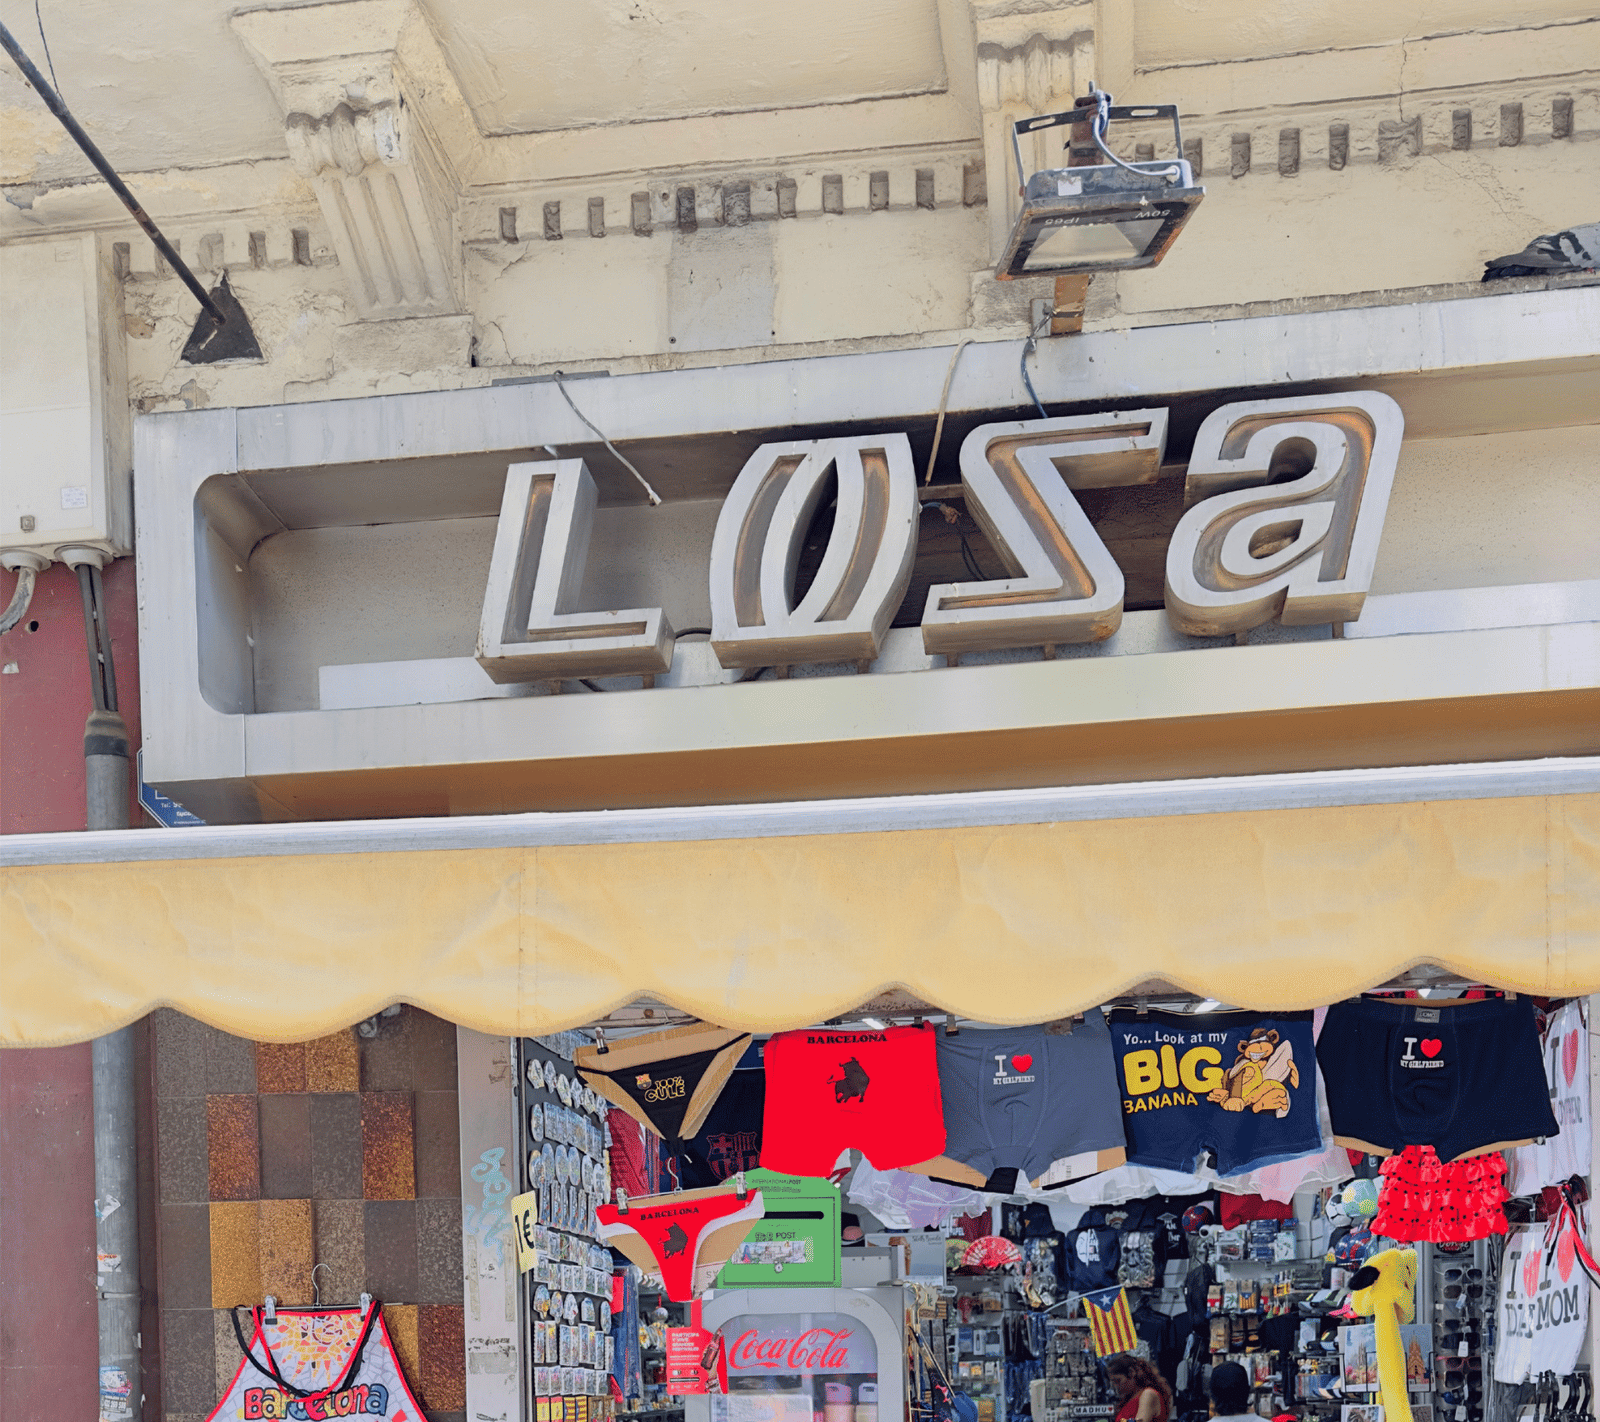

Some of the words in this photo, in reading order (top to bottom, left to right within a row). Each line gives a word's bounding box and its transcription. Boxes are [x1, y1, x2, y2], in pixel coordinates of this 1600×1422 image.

[806, 1033, 888, 1045] BARCELONA
[1123, 1033, 1152, 1046] Yo...
[1155, 1030, 1185, 1045] Look
[1190, 1033, 1203, 1044] at
[1208, 1033, 1228, 1045] my
[1401, 1037, 1418, 1061] I
[994, 1054, 1008, 1077] I
[1123, 1044, 1226, 1096] BIG
[1400, 1060, 1408, 1068] MY
[1408, 1060, 1445, 1069] GIRLFRIEND
[655, 1076, 685, 1090] 100%
[993, 1077, 1002, 1085] MY
[1002, 1075, 1036, 1085] GIRLFRIEND
[1123, 1092, 1199, 1114] BANANA
[639, 1206, 700, 1221] BARCELONA
[514, 1209, 535, 1254] 1€
[776, 1231, 797, 1240] POST
[1536, 1284, 1580, 1332] MOM
[728, 1327, 856, 1370] Coca-Cola
[243, 1383, 389, 1422] Barcelona
[1075, 1406, 1107, 1414] MADHU
